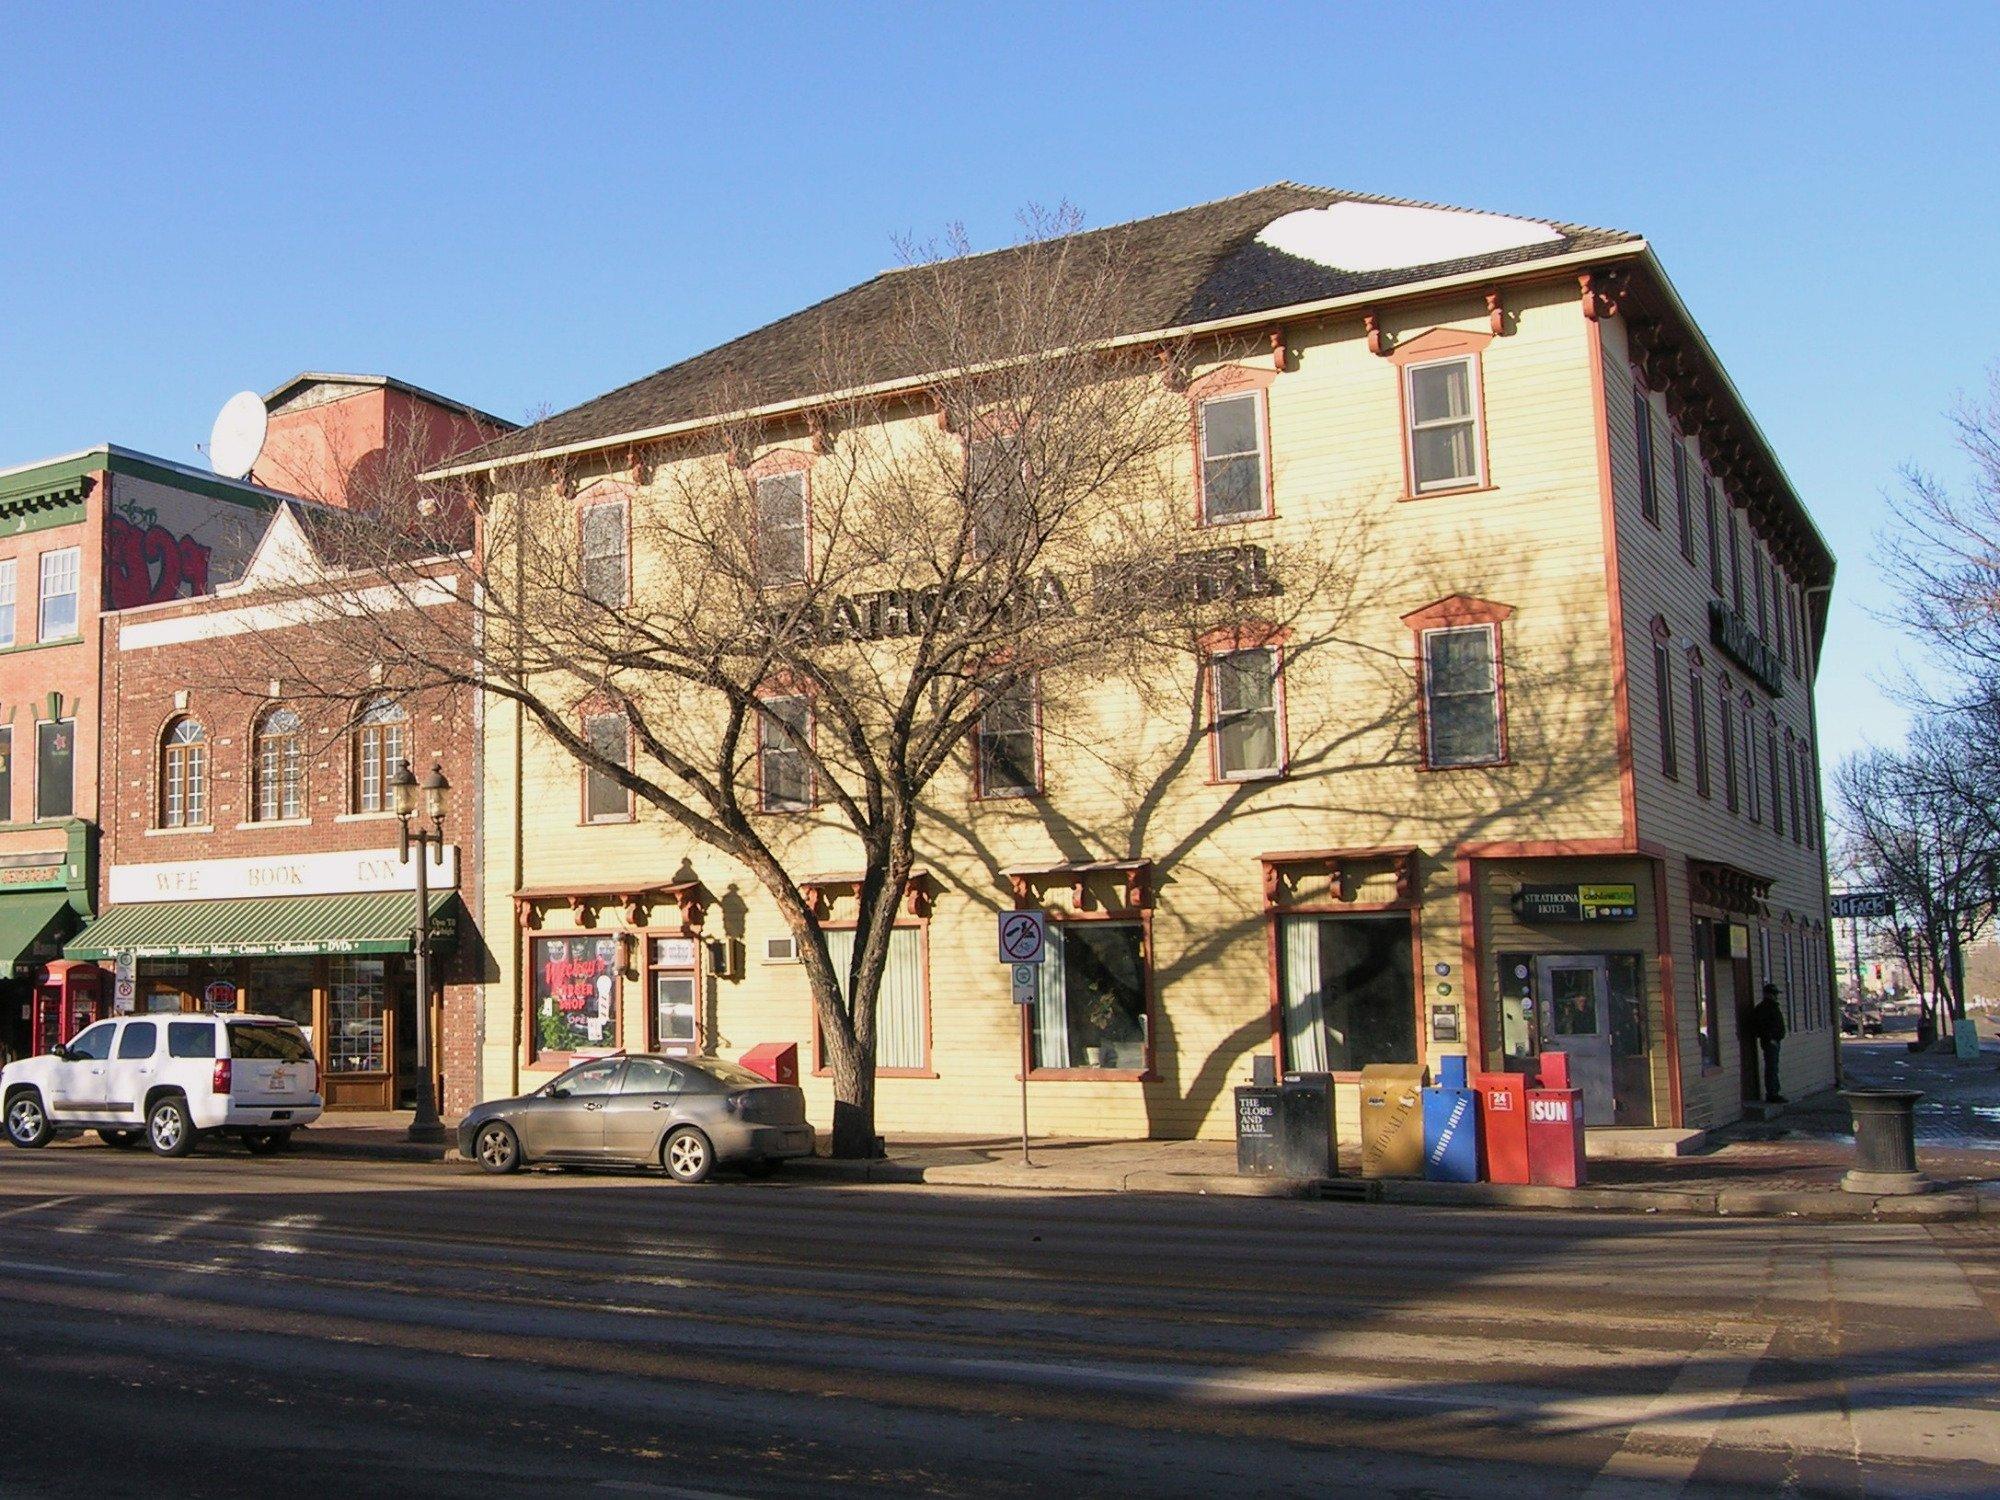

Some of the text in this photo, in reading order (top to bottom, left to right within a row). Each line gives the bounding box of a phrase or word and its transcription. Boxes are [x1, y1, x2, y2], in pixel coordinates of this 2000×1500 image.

[247, 864, 305, 887] BOOK
[1525, 893, 1579, 903] STRATHCONA
[1538, 904, 1567, 914] HOTEL
[327, 939, 352, 952] DVDs
[1240, 1098, 1260, 1107] THE
[1240, 1106, 1273, 1116] GLOBE
[1535, 1101, 1568, 1121] SUN
[1241, 1115, 1263, 1124] AND
[1241, 1123, 1266, 1133] MAIL
